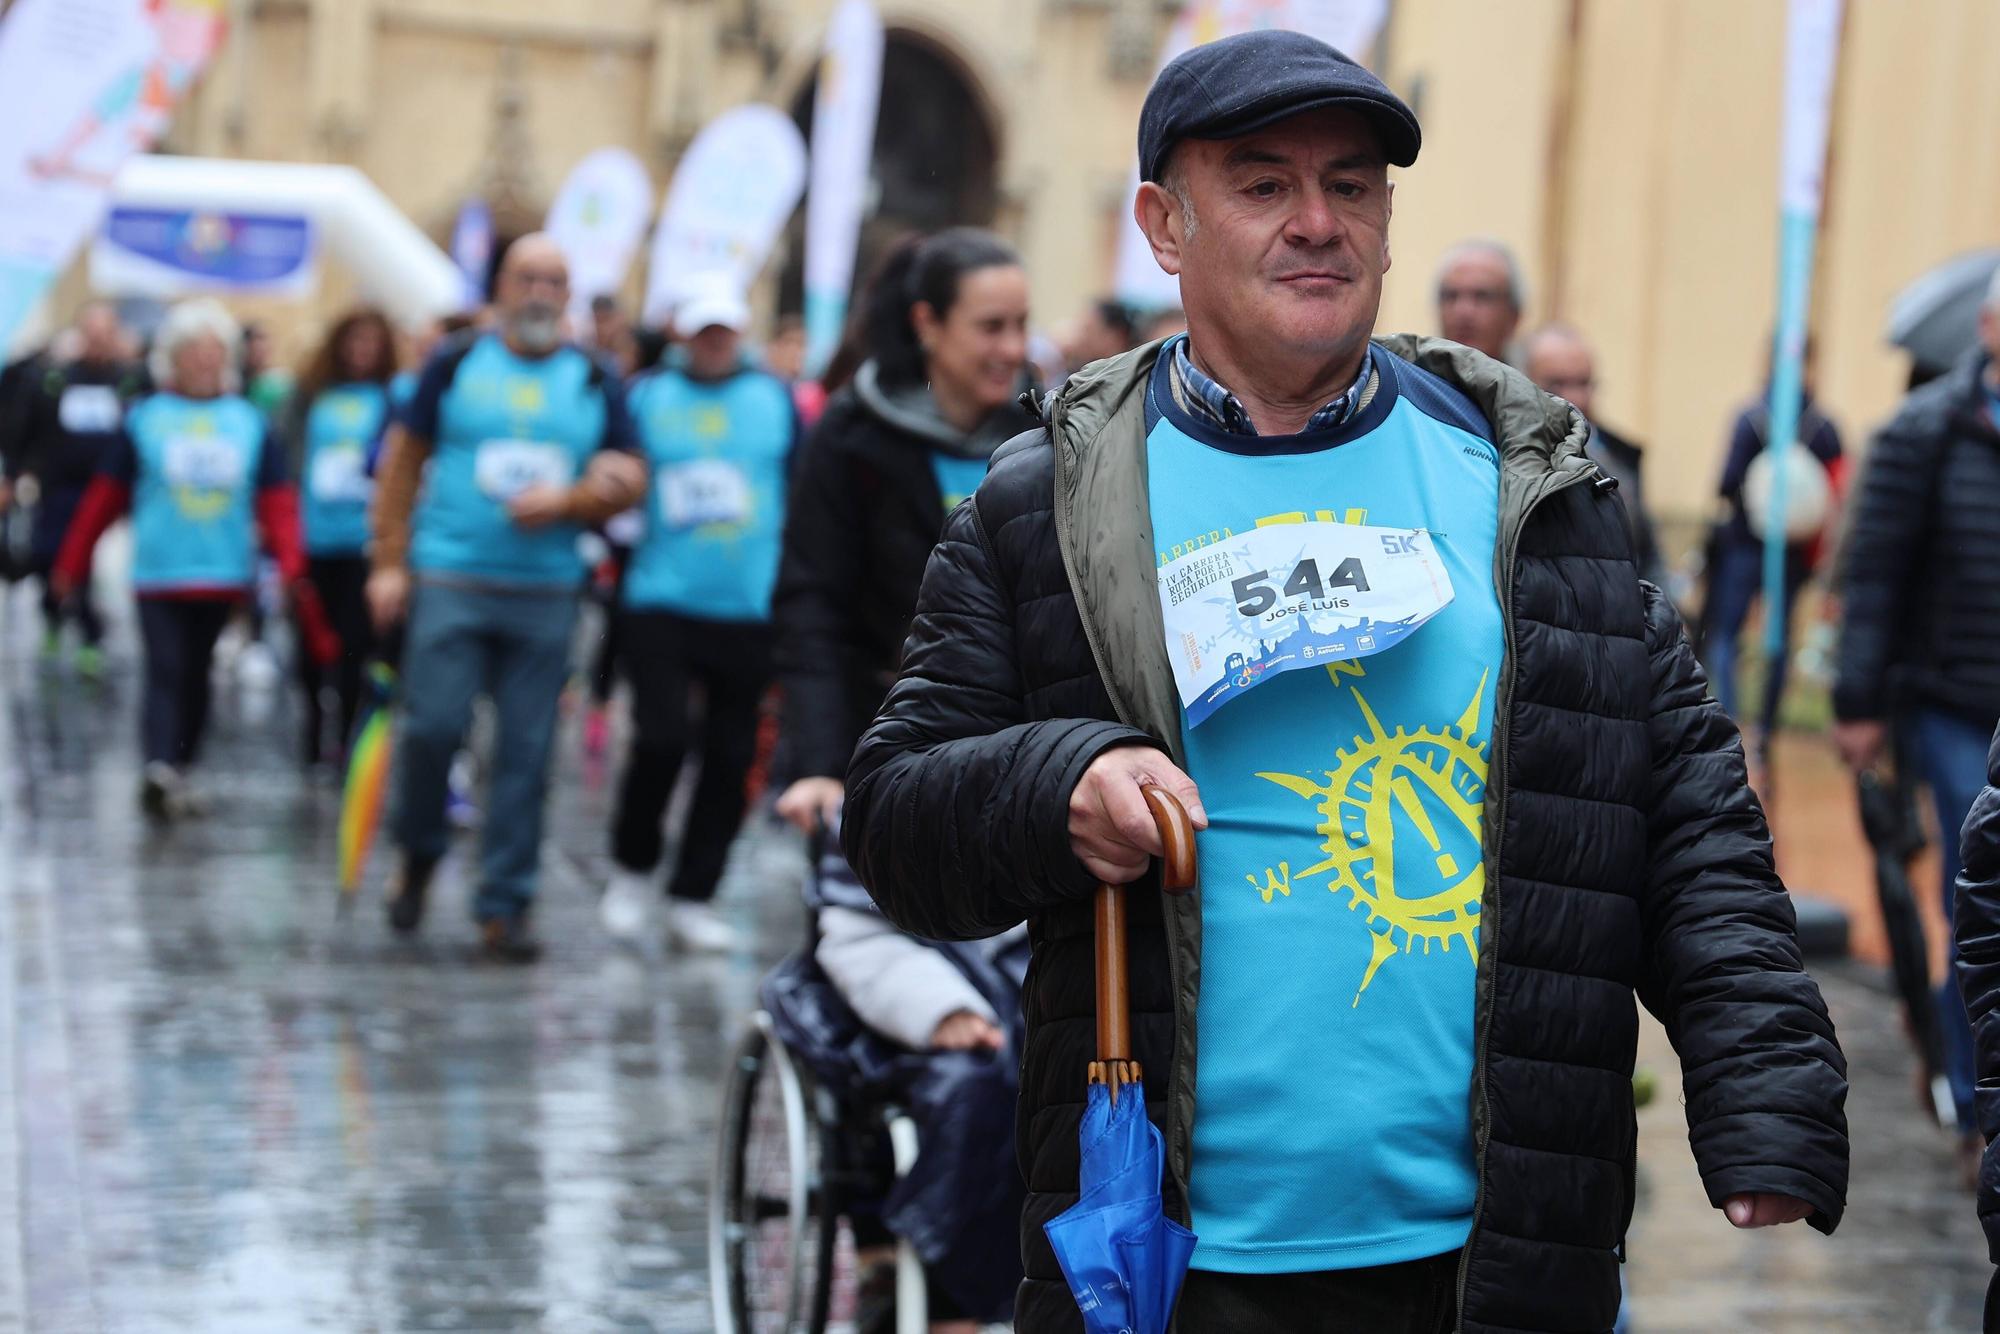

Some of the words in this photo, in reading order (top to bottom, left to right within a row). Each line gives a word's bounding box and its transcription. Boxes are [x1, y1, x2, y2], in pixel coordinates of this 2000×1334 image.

[1463, 446, 1494, 463] RUNN
[1380, 534, 1422, 555] 5K
[1165, 574, 1177, 587] IV
[1179, 551, 1230, 578] CARRERA
[1168, 576, 1193, 597] RUTA
[1194, 564, 1215, 580] POR
[1217, 559, 1232, 570] LA
[1170, 567, 1235, 607] SEGURIDAD
[1231, 557, 1371, 617] 544
[1266, 600, 1308, 622] JOSÉ
[1312, 597, 1350, 611] LUÍS
